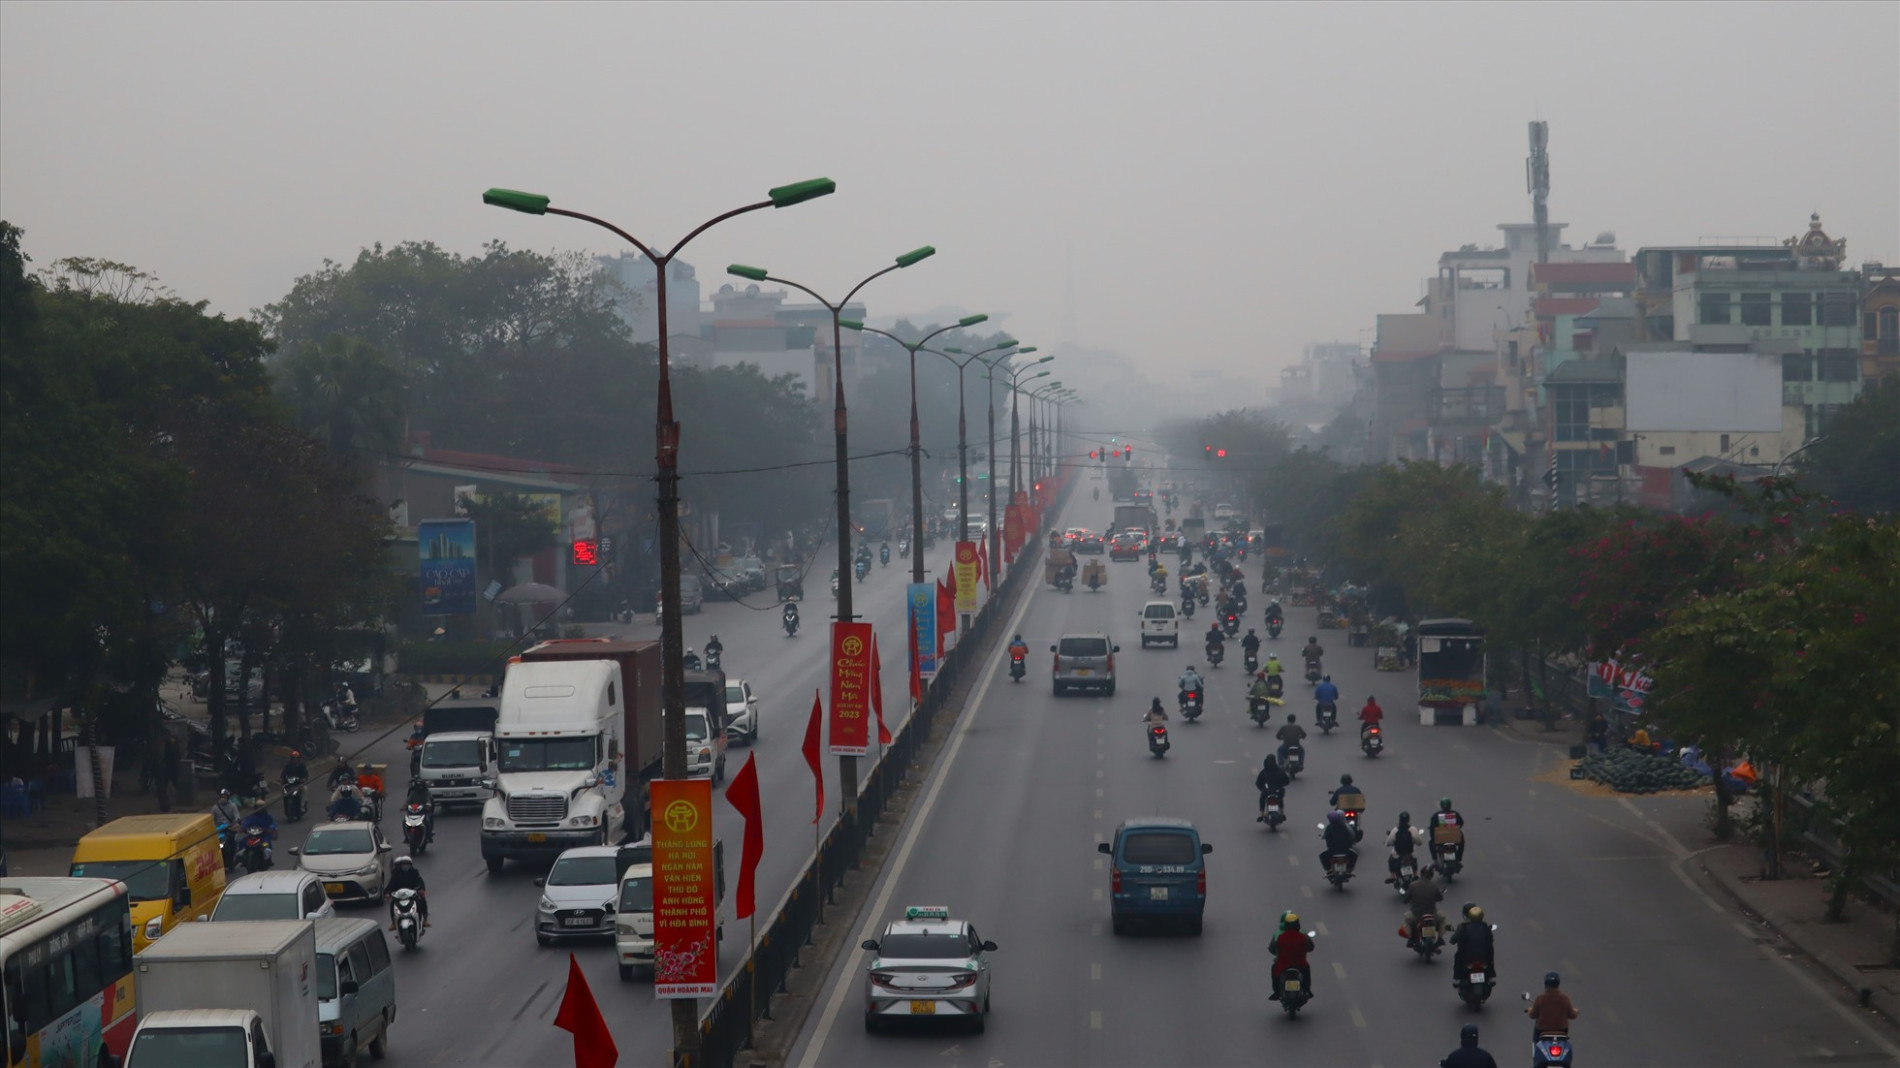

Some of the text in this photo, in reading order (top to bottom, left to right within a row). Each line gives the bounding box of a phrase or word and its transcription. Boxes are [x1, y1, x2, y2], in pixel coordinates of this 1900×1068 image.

[839, 710, 860, 719] 2023
[656, 839, 684, 848] THĂNG
[668, 850, 696, 860] HÀ NỘI
[661, 862, 703, 871] NGÀN NĂM
[664, 873, 680, 882] VĂN
[686, 884, 699, 894] ĐÔ
[662, 896, 705, 905] ANH HÙNG
[660, 905, 708, 917] THÀNH PHỐ
[659, 918, 667, 928] VÌ
[689, 918, 709, 928] BÌNH
[658, 985, 676, 995] QUẬN
[677, 985, 699, 994] HOÀNG
